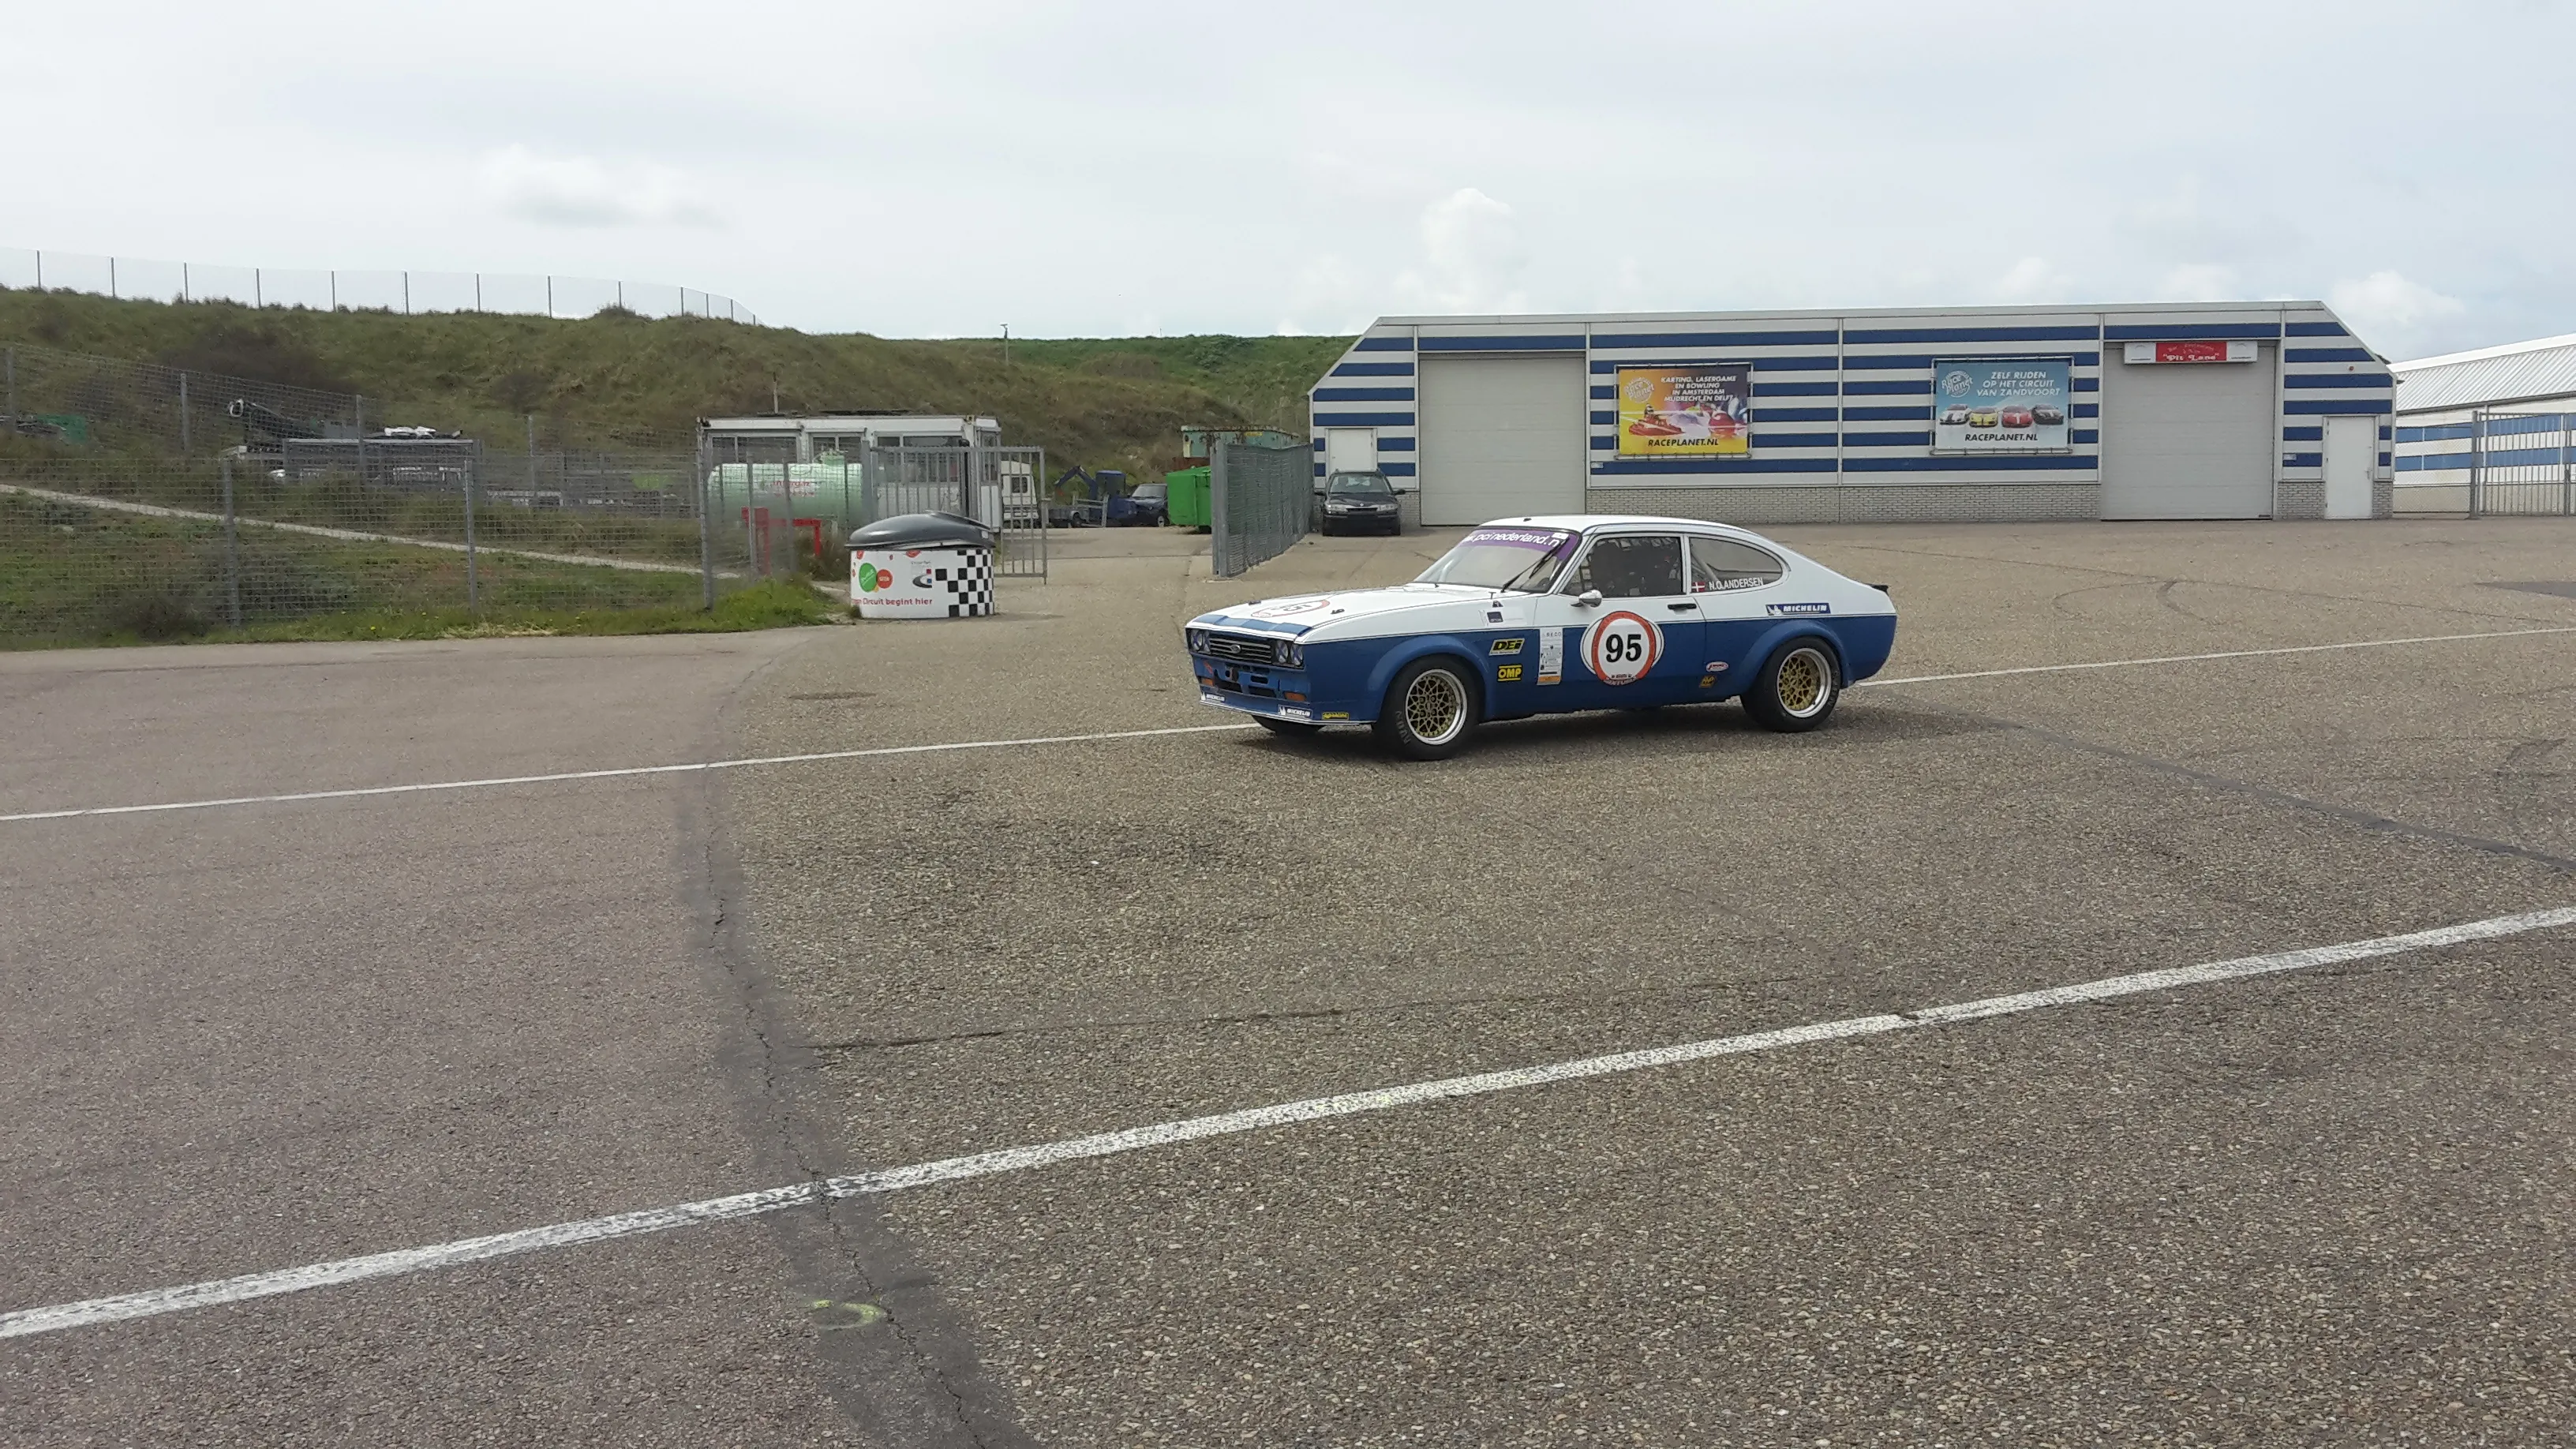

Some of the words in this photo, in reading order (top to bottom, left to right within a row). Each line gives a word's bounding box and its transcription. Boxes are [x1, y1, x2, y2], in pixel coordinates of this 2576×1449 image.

[2000, 388, 2061, 397] ZANDVOORT
[1964, 433, 2039, 442] RACEPLANET.NL
[1648, 438, 1719, 447] RACEPLANET.NL
[886, 597, 912, 607] begint
[1605, 634, 1642, 663] 95
[1498, 668, 1522, 679] OMP
